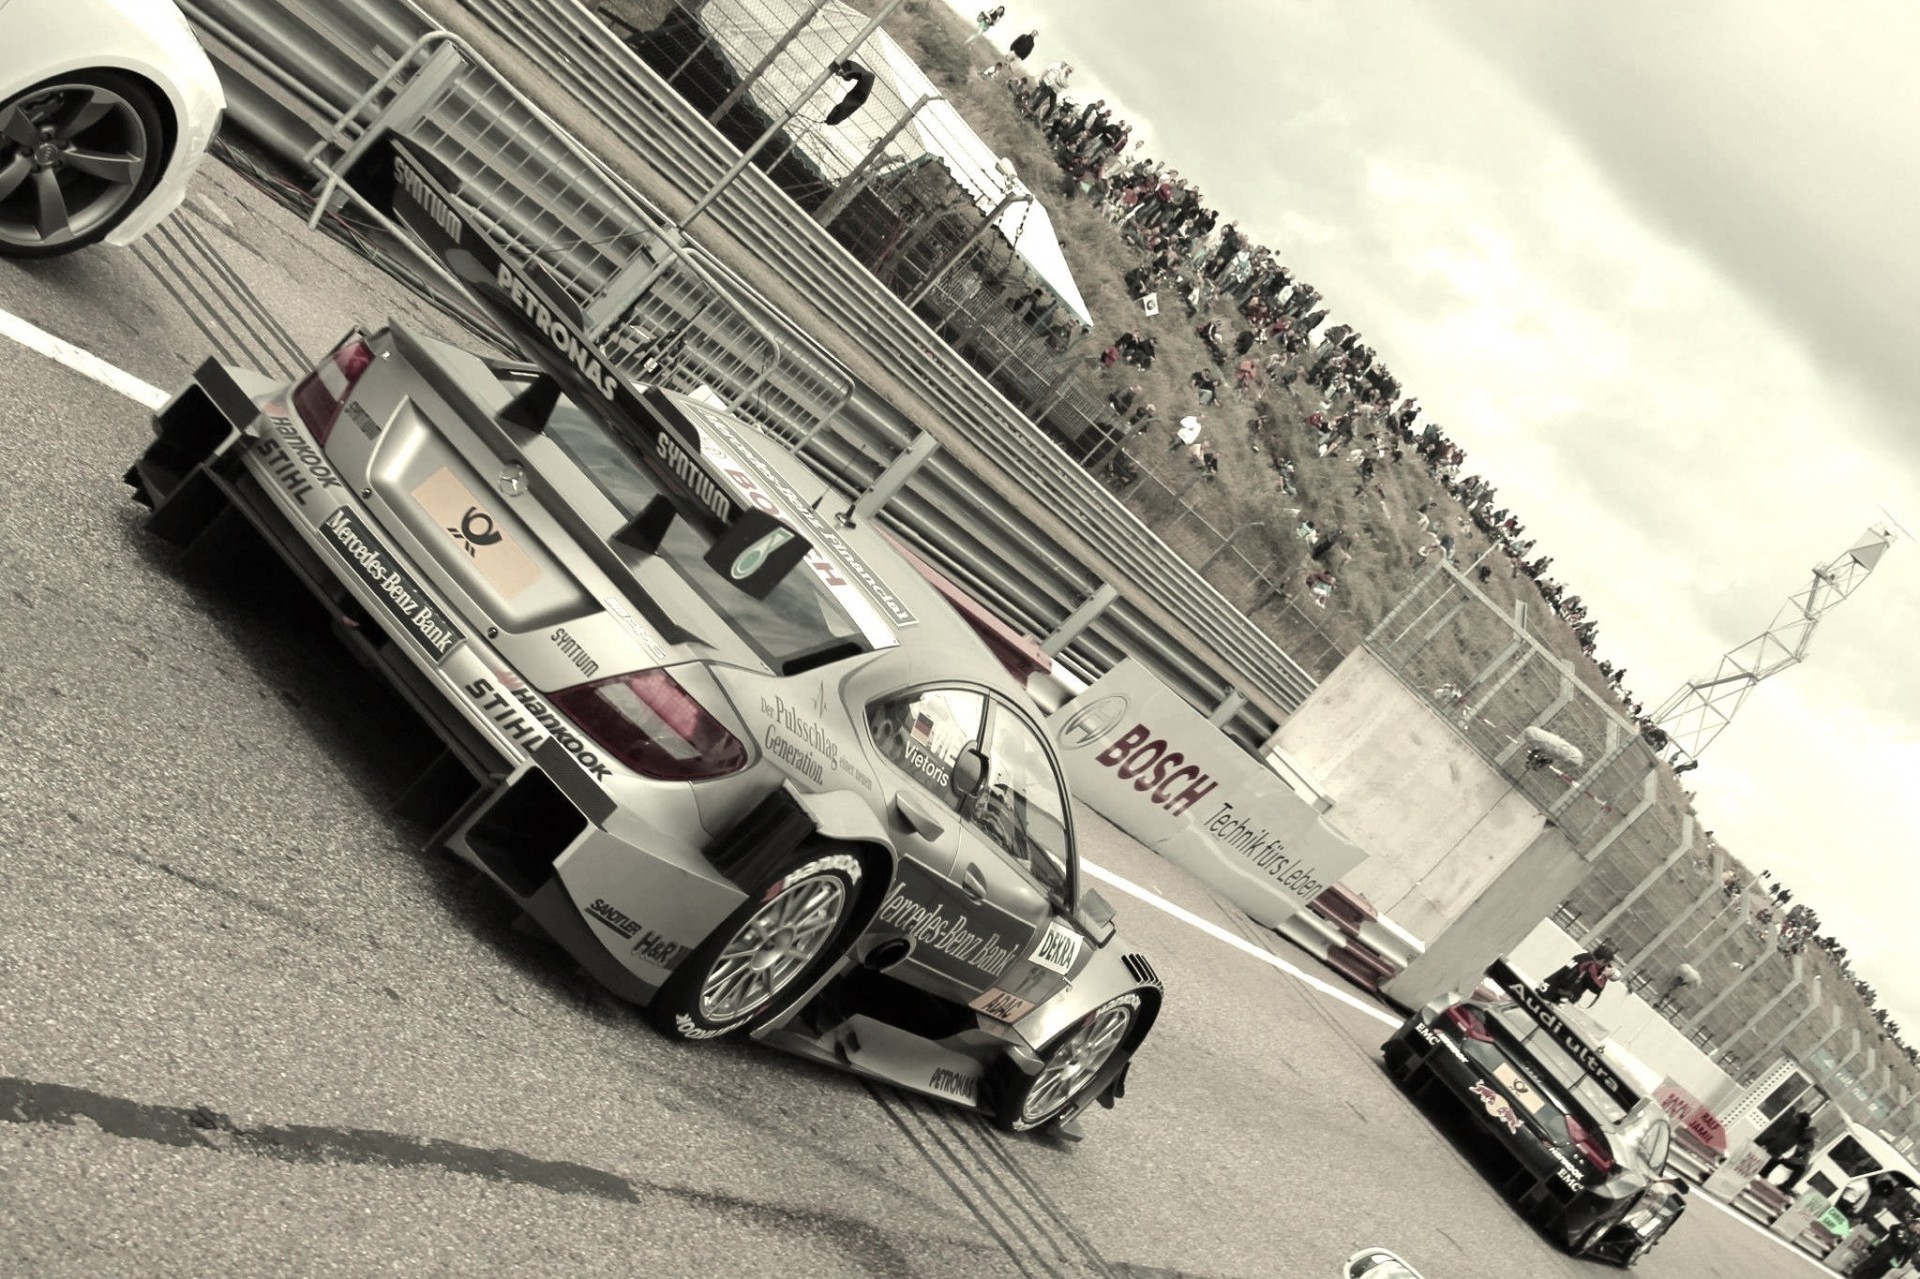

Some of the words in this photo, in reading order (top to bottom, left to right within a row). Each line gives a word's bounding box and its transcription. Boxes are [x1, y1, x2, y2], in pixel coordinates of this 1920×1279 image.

[393, 157, 463, 245] SYNTIUM
[496, 264, 616, 399] PETRONAS
[257, 440, 314, 508] STIHL
[657, 434, 731, 524] SYNTIUM
[725, 469, 846, 586] BOH
[327, 510, 418, 616] Mercedes-Benz
[412, 605, 453, 653] Bank
[822, 533, 909, 619] Financial
[551, 627, 599, 678] SYNTIUM
[466, 680, 543, 754] STIHL
[774, 695, 839, 769] Pulsschlag
[765, 724, 824, 787] Generation.
[904, 743, 950, 788] Vietoris
[1095, 723, 1219, 817] BOSCH
[1205, 802, 1268, 859] Technik
[1278, 858, 1324, 900] Leben
[590, 898, 642, 930] SANDTLER
[634, 930, 673, 965] H&R
[975, 921, 1020, 976] Bank
[1038, 933, 1076, 967] DEKRA
[977, 992, 1022, 1021] ADAC
[1509, 982, 1562, 1036] Audi
[1566, 1036, 1619, 1092] ultra
[930, 1067, 976, 1098] PETRONAS
[1688, 1120, 1714, 1143] JAMIE
